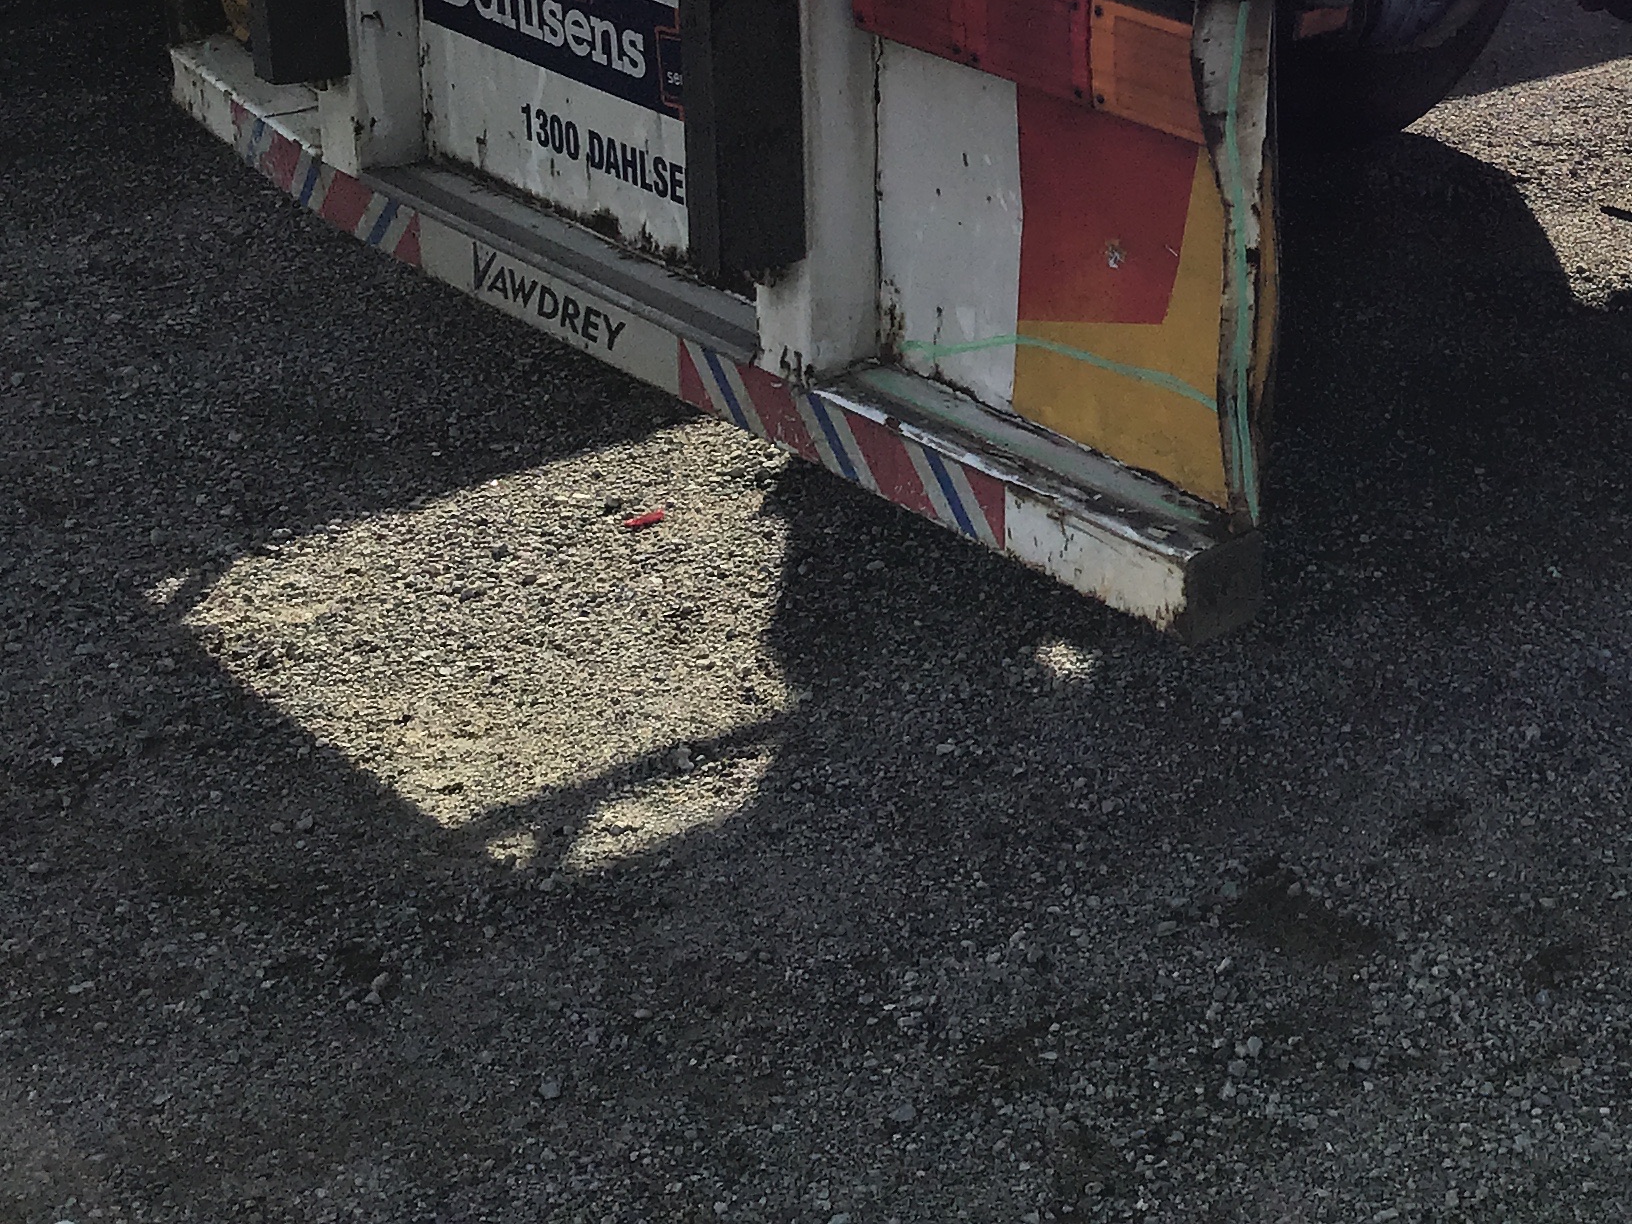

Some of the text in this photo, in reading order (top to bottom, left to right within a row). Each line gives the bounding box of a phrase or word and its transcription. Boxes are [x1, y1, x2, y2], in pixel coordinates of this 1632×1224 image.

[520, 102, 685, 206] 1300 DAHLSE
[472, 241, 627, 352] VAWDREY
